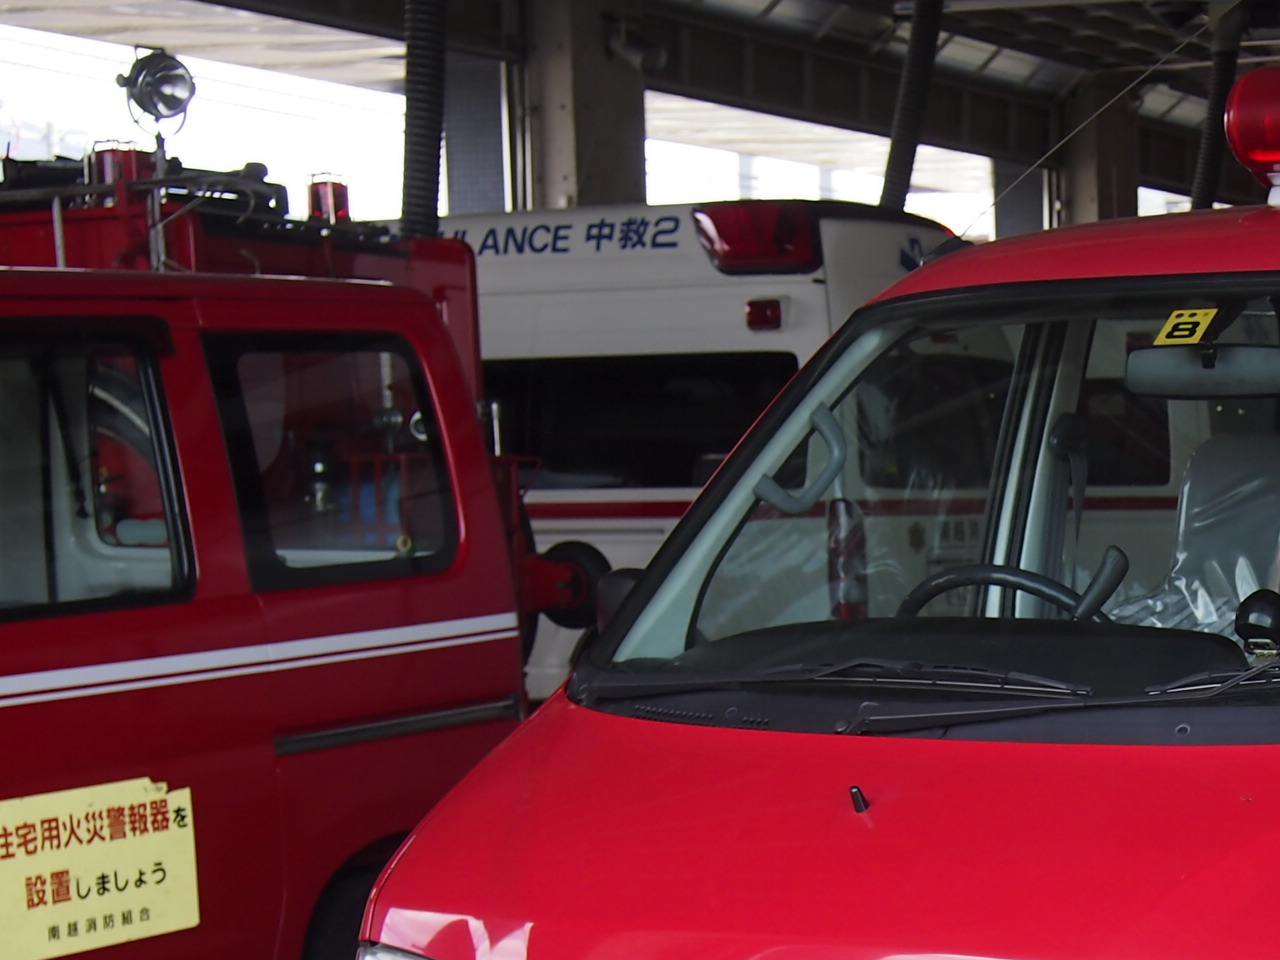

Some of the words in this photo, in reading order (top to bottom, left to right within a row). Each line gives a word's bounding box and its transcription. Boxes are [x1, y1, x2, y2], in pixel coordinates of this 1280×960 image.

[585, 216, 680, 251] 中救2
[1165, 321, 1201, 340] 8
[25, 862, 167, 910] 設置しましょう
[48, 907, 151, 942] 南越消防組合
